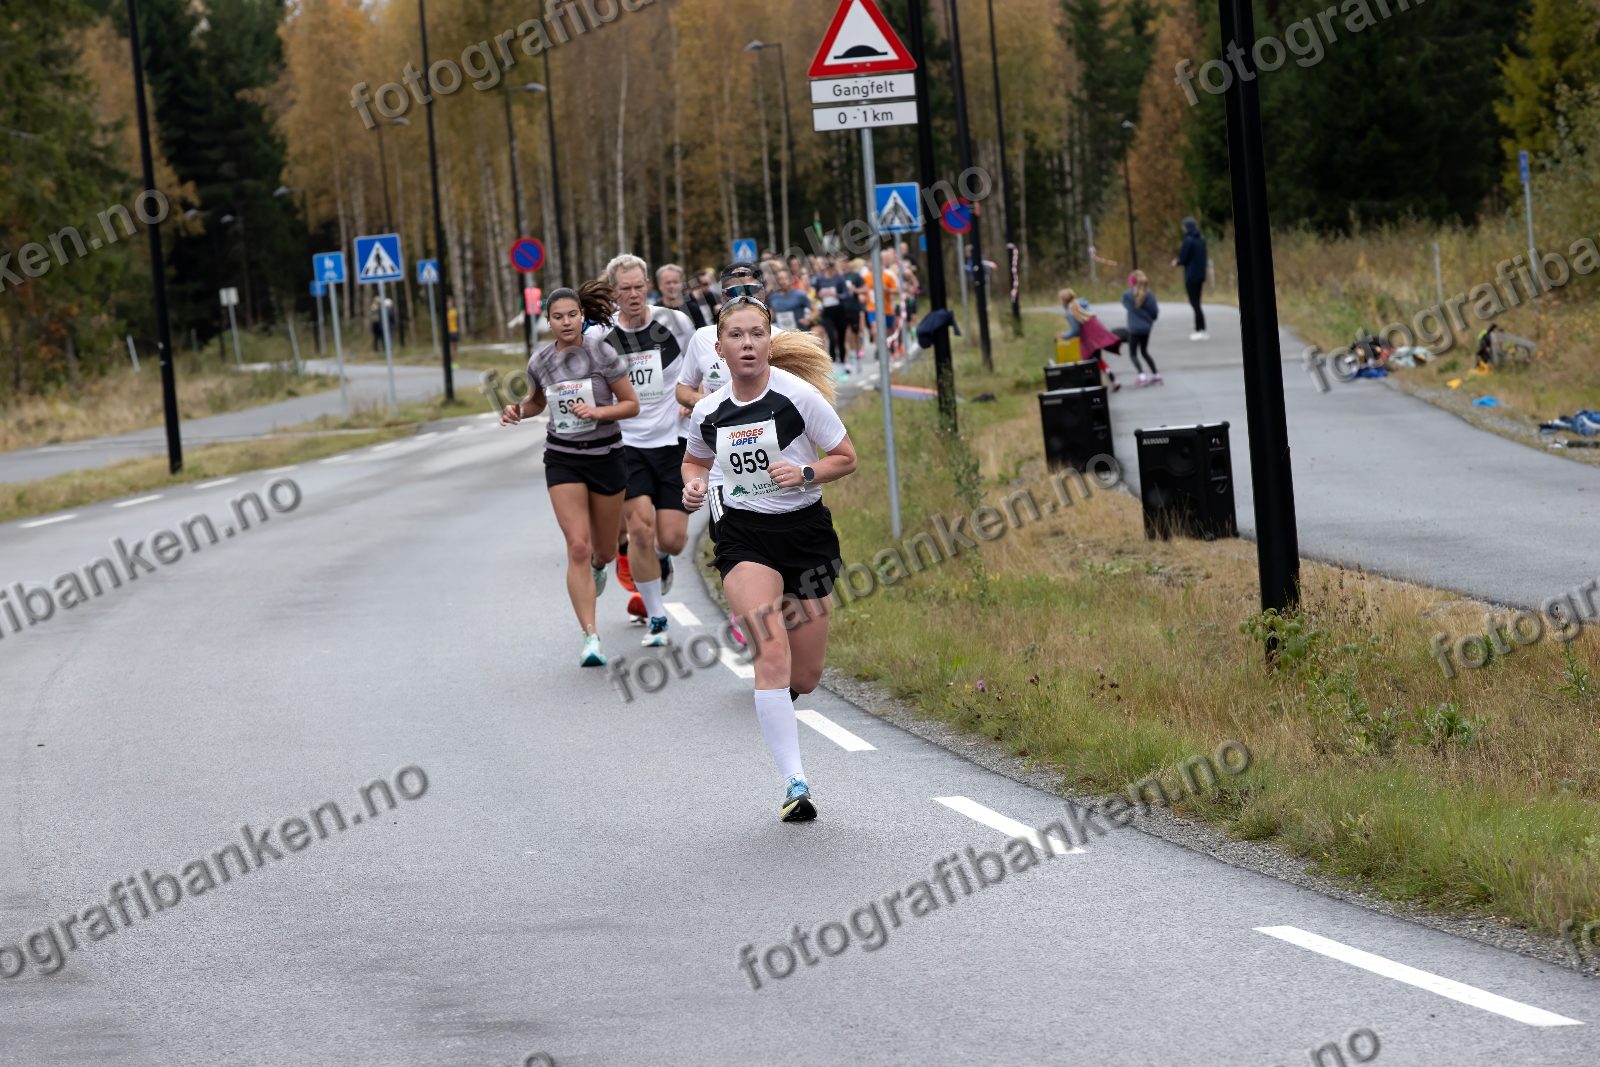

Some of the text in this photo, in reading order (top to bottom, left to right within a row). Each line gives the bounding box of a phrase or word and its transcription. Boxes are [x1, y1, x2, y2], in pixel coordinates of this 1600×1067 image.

[832, 80, 895, 98] Gangfelt
[837, 111, 848, 125] 0
[862, 110, 868, 122] 1
[872, 109, 894, 122] km
[628, 368, 653, 386] 407
[727, 428, 764, 440] NORGES
[731, 436, 759, 447] LØPET
[729, 448, 770, 475] 959
